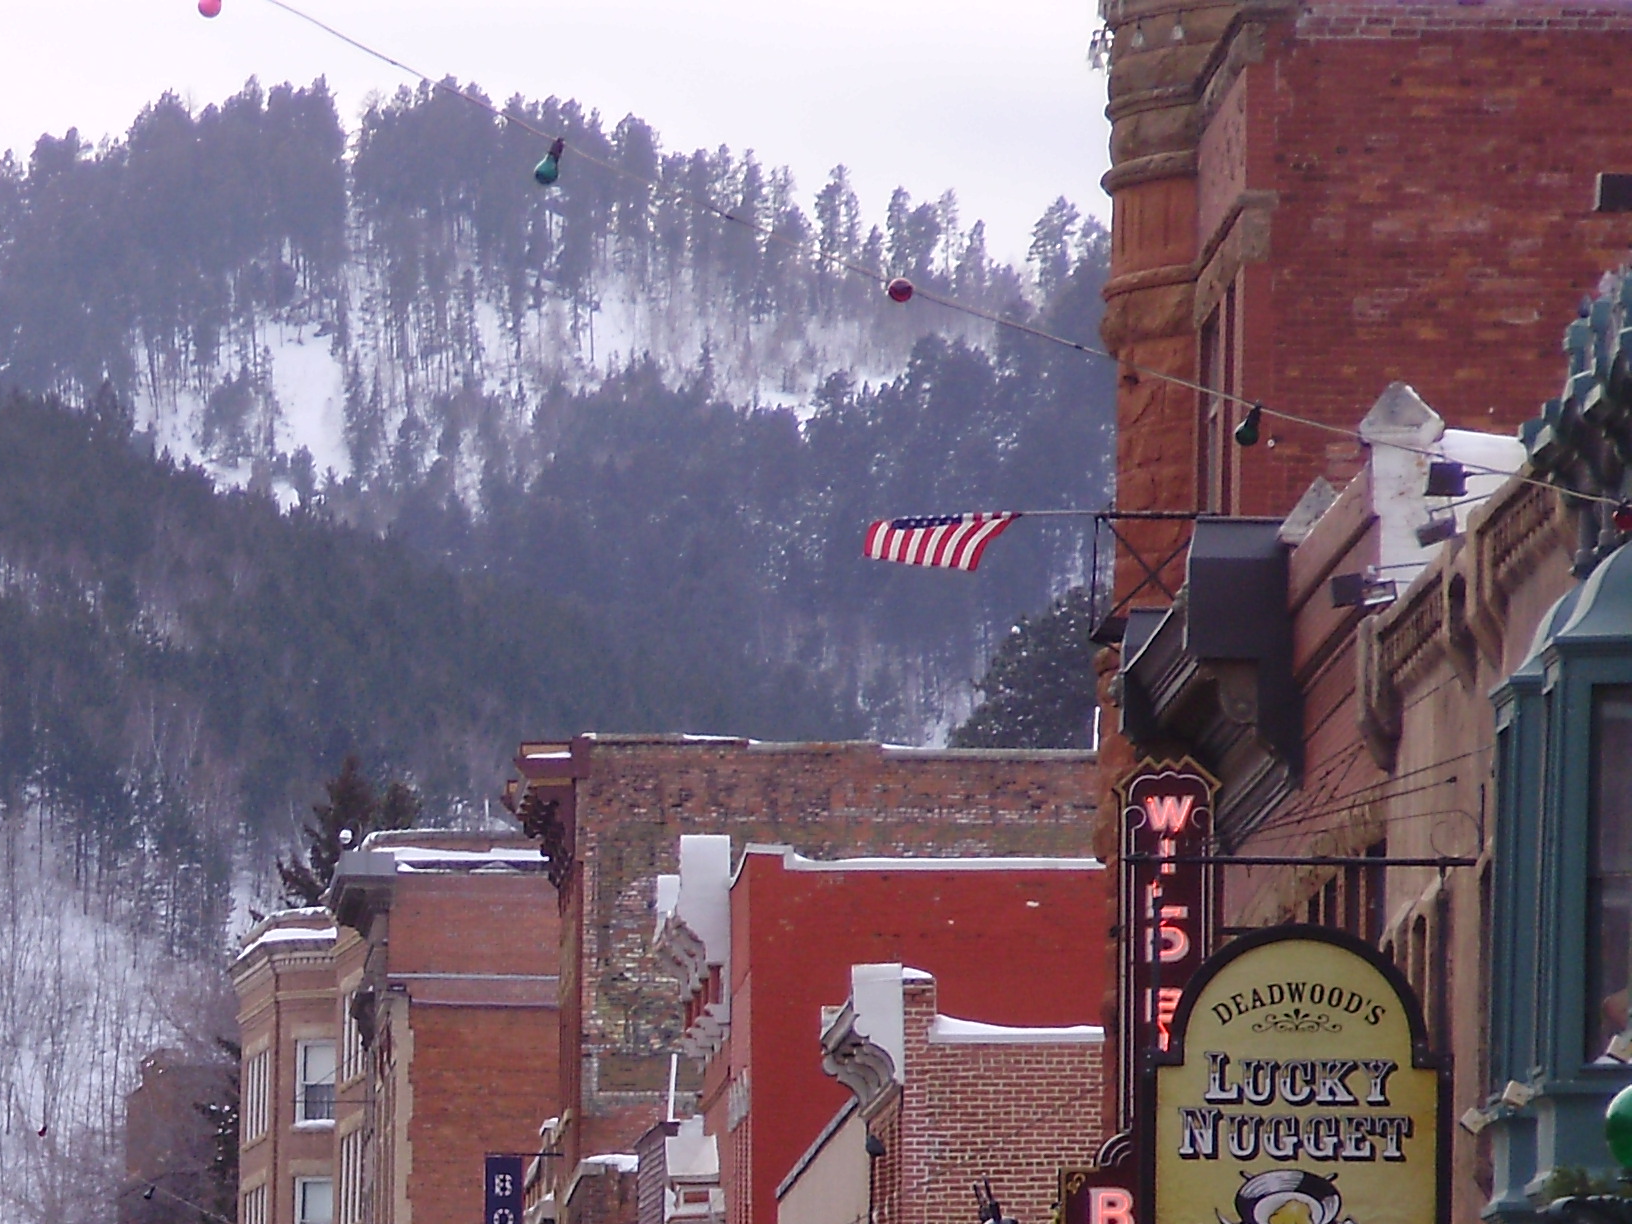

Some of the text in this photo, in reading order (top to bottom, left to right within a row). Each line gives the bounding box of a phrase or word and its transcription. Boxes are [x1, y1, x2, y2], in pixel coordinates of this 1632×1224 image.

[1211, 981, 1386, 1026] DEADWOOD'S
[1204, 1051, 1399, 1107] LUCKY
[1178, 1106, 1414, 1162] NUGGET
